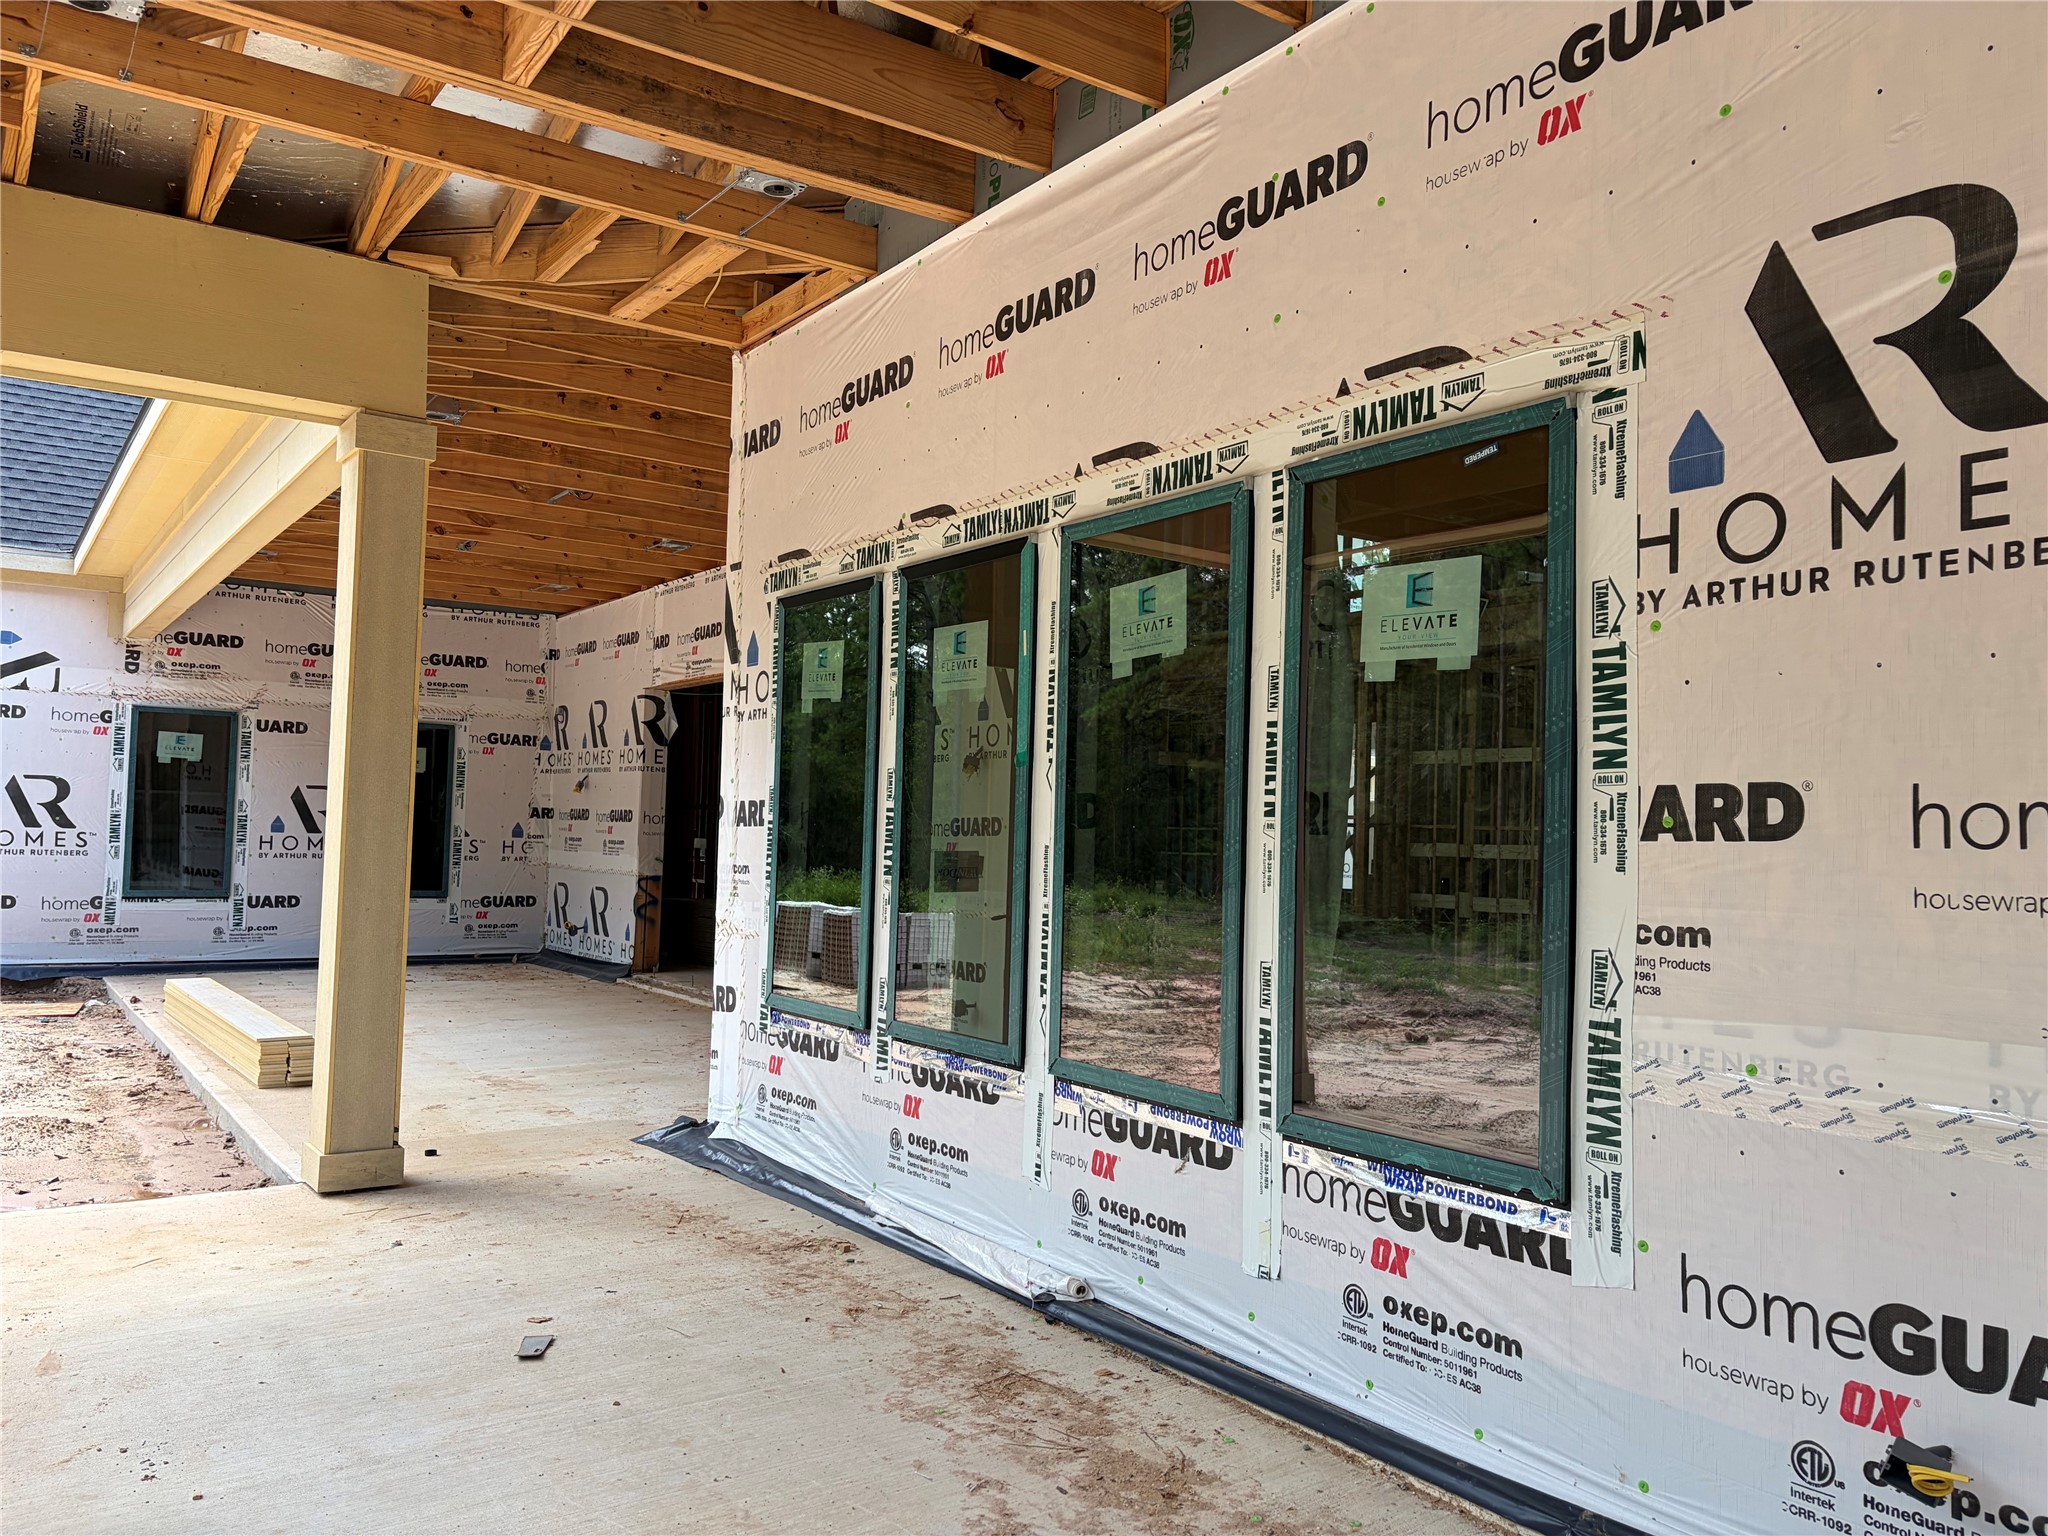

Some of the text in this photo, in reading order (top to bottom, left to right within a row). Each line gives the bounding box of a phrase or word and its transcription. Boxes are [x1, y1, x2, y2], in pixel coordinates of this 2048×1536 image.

[1425, 92, 1588, 192] housewap by OX
[1133, 139, 1369, 281] homeGUARD
[1132, 248, 1235, 316] housewap by OX
[939, 268, 1096, 369] homeGUARD
[1552, 341, 1605, 358] www.tamlyn.com
[1559, 350, 1598, 367] 800-334-1676
[1619, 339, 1628, 371] ROLL ON
[973, 349, 1007, 385] by OX
[1544, 365, 1612, 390] XtremeFlashing
[799, 354, 914, 434] homeGUARD
[1444, 375, 1482, 398] TAMLYN
[1353, 385, 1437, 441] TAMLYN
[1597, 402, 1624, 417] ROLL ON
[834, 420, 850, 444] OX
[1219, 443, 1247, 462] TAMLYN
[1291, 435, 1339, 456] XtremeFlashing
[1464, 444, 1498, 465] TEMPERED
[1614, 418, 1627, 500] XtremeFlashing
[1152, 450, 1213, 496] TAMLYN
[1053, 493, 1074, 508] TAMLYN
[1003, 498, 1050, 534] TAMLYN
[856, 540, 891, 571] TAMLYN
[769, 567, 798, 592] TAMLYN
[1682, 566, 1830, 610] ARTHUR
[215, 590, 307, 606] ARTHUR RUTENBERG
[1595, 583, 1609, 634] TAMLYN
[463, 615, 494, 624] ARTHUR
[496, 618, 541, 629] RUTENBERG
[676, 621, 723, 646] homeGUARD
[1122, 616, 1173, 638] ELEVATE
[1380, 613, 1458, 633] ELEVATE
[166, 647, 183, 657] OX
[602, 630, 640, 650] homeGUARD
[171, 661, 221, 670] oxep.com
[302, 658, 317, 668] OX
[424, 668, 437, 677] OX
[941, 658, 978, 672] ELEVATE
[1269, 668, 1280, 709] TAMLYN
[1592, 641, 1627, 770] TAMLYN
[93, 726, 109, 735] OX
[113, 726, 126, 757] TAMLYN
[240, 730, 252, 762] TAMLYN
[482, 746, 495, 755] OX
[577, 750, 610, 765] HOMES
[456, 760, 466, 792] TAMLYN
[1597, 774, 1624, 784] ROLL ON
[236, 813, 248, 844] TAMLYN
[595, 809, 634, 823] homeGUARD
[109, 813, 121, 845] TAMLYN
[1615, 792, 1628, 874] XtremeFlashing
[30, 848, 89, 857] RUTENBERG
[452, 839, 463, 866] TAMLYN
[83, 913, 101, 922] OX
[232, 897, 244, 927] TAMLYN
[475, 911, 488, 919] OX
[86, 926, 140, 934] oxep.com
[579, 934, 613, 956] HOMES
[1659, 956, 1711, 972] Products
[1261, 965, 1271, 1006] TAMLYN
[1593, 955, 1608, 1006] TAMLYN
[768, 1054, 783, 1076] OX
[965, 1062, 1008, 1082] POWERBOND
[1586, 1018, 1622, 1148] TAMLYN
[771, 1086, 817, 1110] oxep.com
[893, 1093, 922, 1120] by OX
[1769, 1097, 1801, 1114] Styrofoam
[1879, 1096, 1915, 1114] Styrofoam
[1150, 1105, 1209, 1130] POWERBOND
[1820, 1112, 1854, 1129] Styrofoam
[907, 1132, 969, 1163] oxep.com
[1996, 1128, 2034, 1145] Styrofoam
[1078, 1149, 1118, 1182] by OX
[1590, 1150, 1618, 1162] ROLL ON
[1383, 1174, 1519, 1216] WRAP POWERBOND
[1098, 1196, 1187, 1239] oxep.com
[1610, 1171, 1622, 1255] XtremeFlashing
[1098, 1217, 1186, 1257] HomeGuard Products
[1349, 1236, 1410, 1279] by OX
[1341, 1319, 1368, 1336] Intertek
[1382, 1295, 1523, 1361] oxep.com
[1382, 1321, 1523, 1382] HomeGuard Building Products
[1382, 1336, 1478, 1380] Control Number: 5011961
[1382, 1348, 1482, 1394] Certified AC38
[1682, 1348, 1912, 1438] housewrap by OX
[1789, 1487, 1836, 1512] Intertek
[1863, 1494, 1965, 1536] HomeGuard
